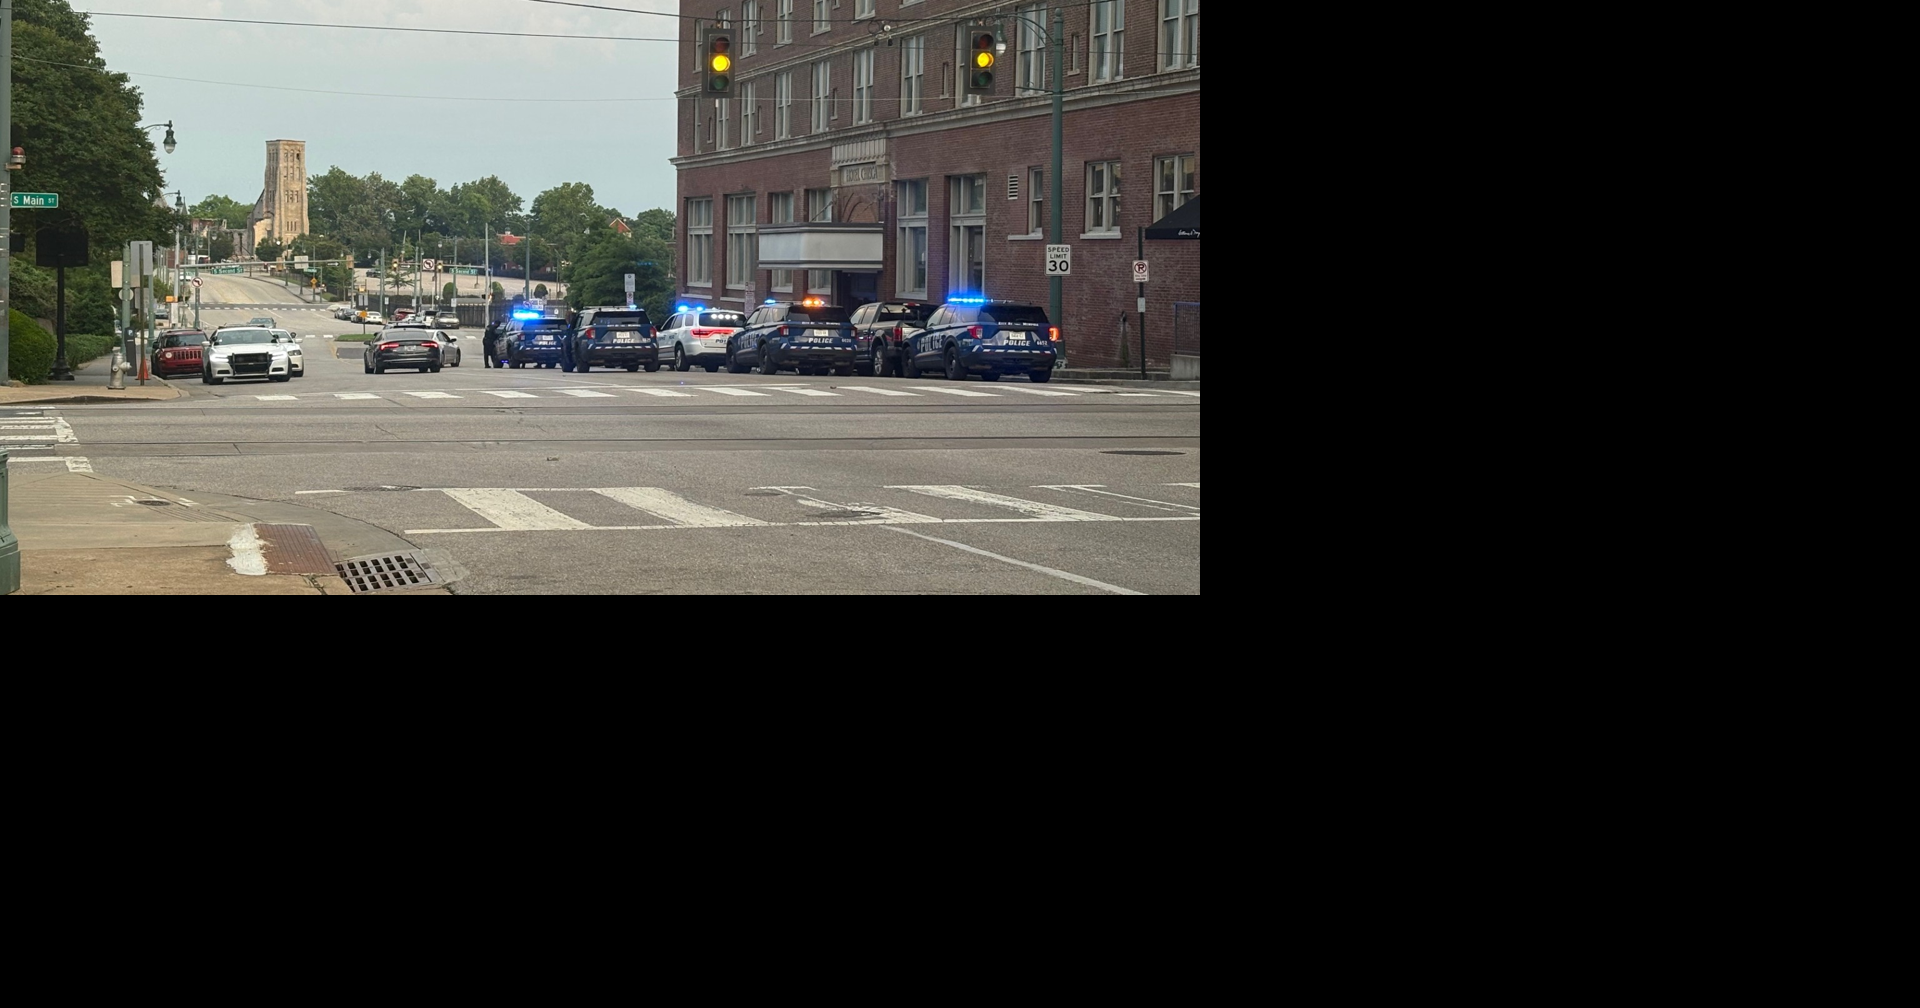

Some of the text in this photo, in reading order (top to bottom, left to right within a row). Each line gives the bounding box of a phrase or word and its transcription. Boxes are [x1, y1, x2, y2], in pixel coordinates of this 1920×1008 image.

[13, 195, 19, 204] S
[23, 195, 44, 205] Main
[1048, 260, 1069, 272] 30
[1003, 339, 1031, 347] POLICE
